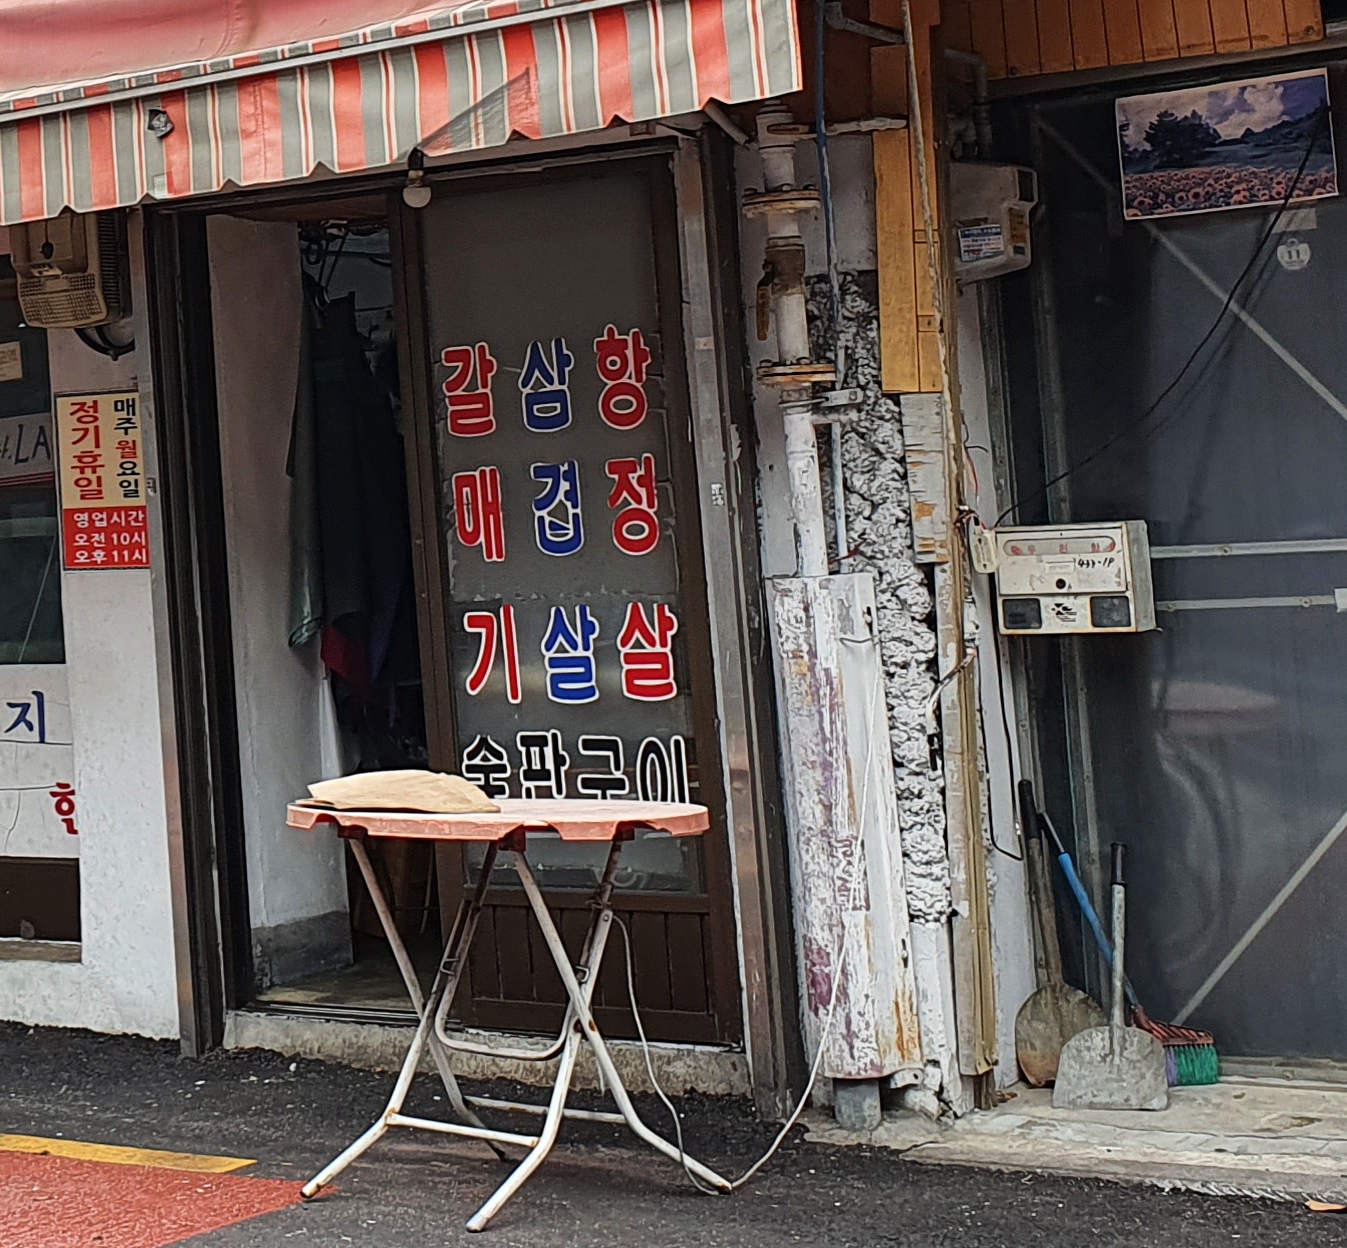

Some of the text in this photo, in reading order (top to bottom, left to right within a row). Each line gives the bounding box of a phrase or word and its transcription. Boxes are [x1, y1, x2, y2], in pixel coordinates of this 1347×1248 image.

[69, 399, 105, 501] 정기휴일
[113, 397, 141, 499] 매주 월요일
[73, 511, 146, 528] 영업시간
[73, 532, 146, 547] 오전 10시
[74, 549, 147, 564] 오후 11시
[441, 341, 523, 705] 갈매기
[518, 336, 601, 705] 삼겹살
[593, 323, 679, 703] 항정살
